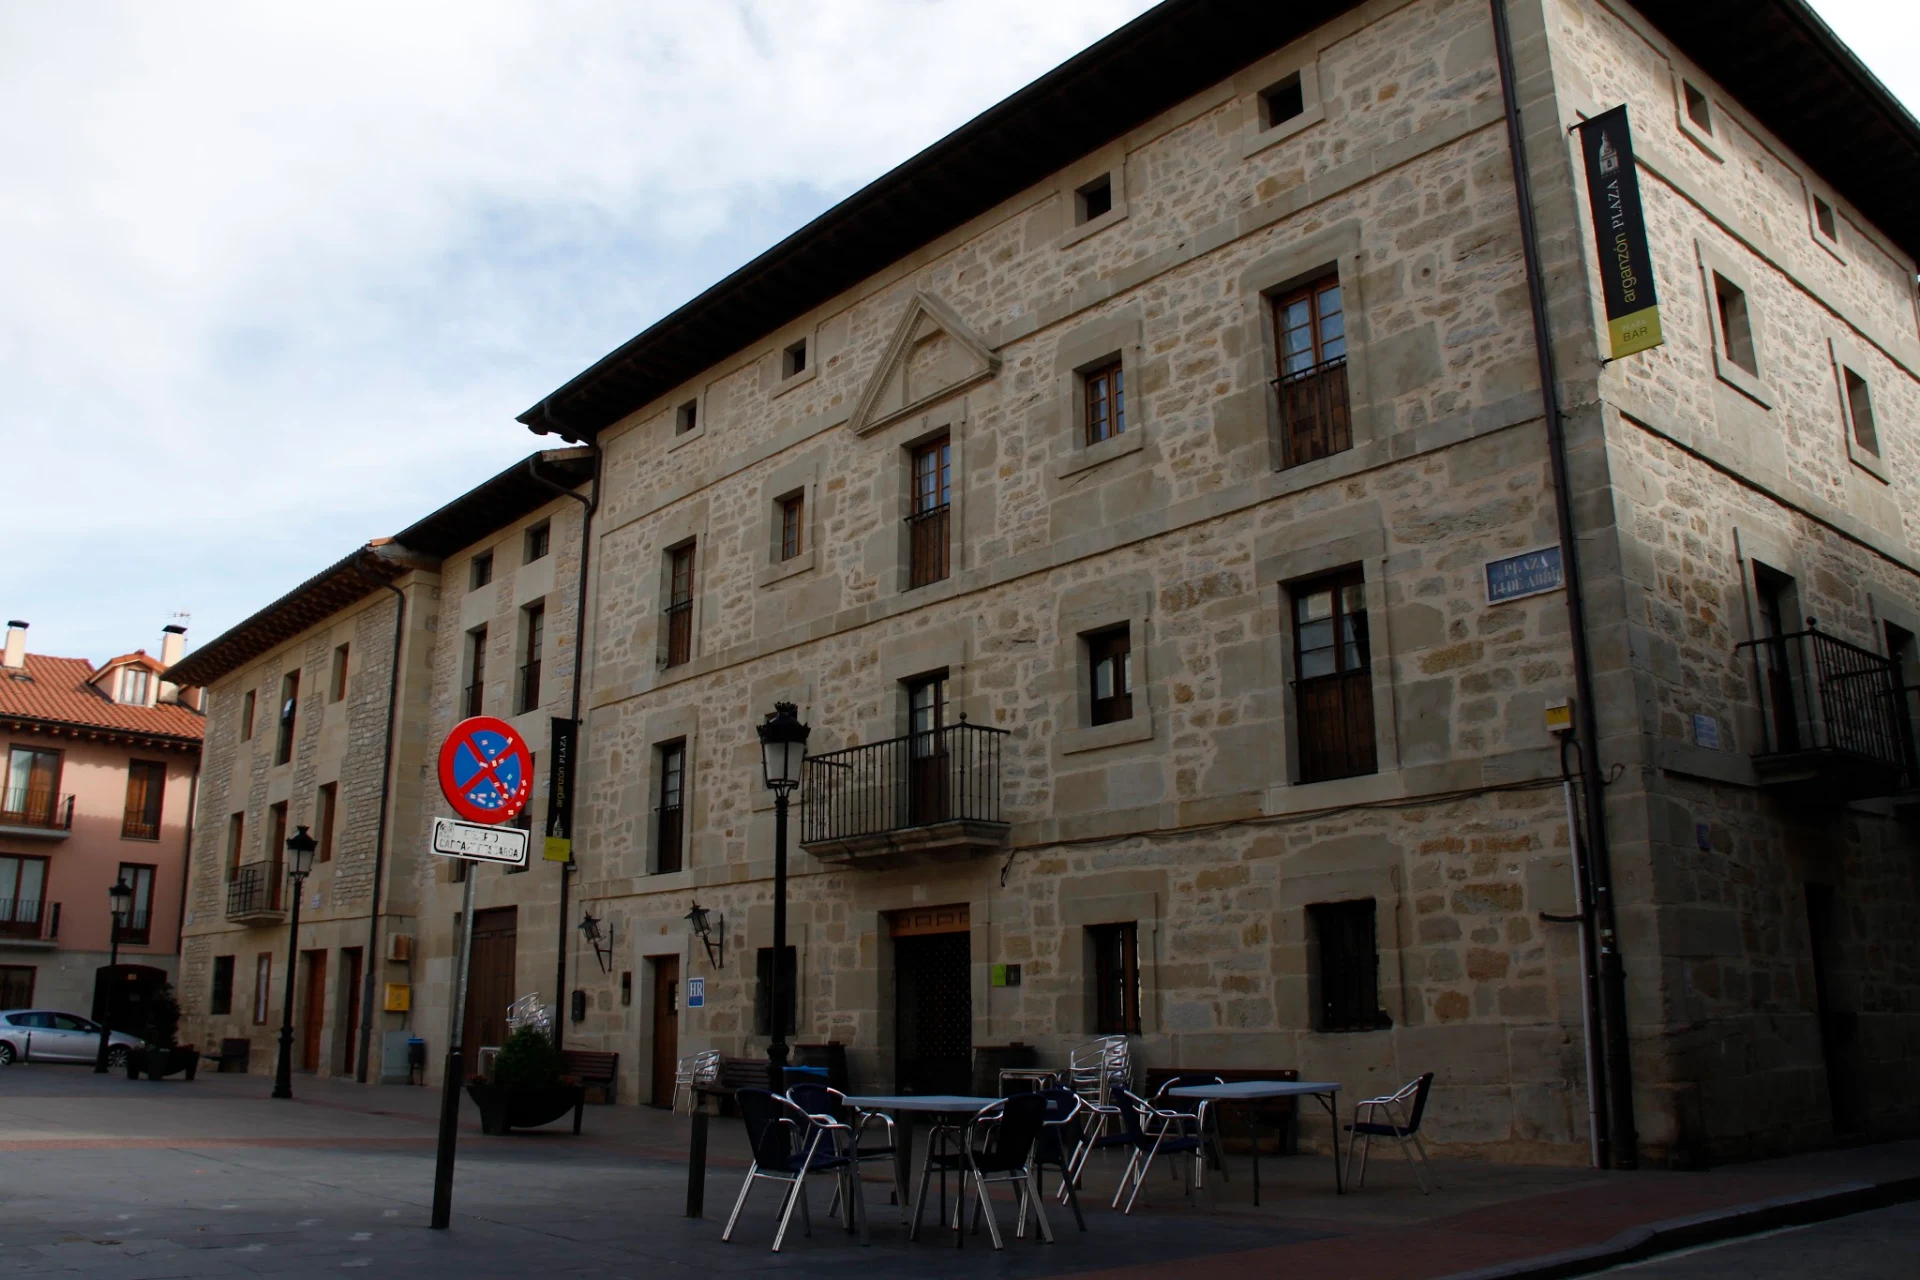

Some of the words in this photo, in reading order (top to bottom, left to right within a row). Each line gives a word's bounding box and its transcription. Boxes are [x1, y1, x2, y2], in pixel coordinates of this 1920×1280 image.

[1606, 179, 1625, 230] PLAZA
[1614, 232, 1637, 303] arganzón
[1622, 326, 1648, 342] BAR
[1504, 555, 1549, 576] PLAZA
[1492, 581, 1506, 596] 14
[1507, 577, 1524, 593] DE
[1526, 567, 1561, 588] ABRIL
[558, 735, 567, 764] PLAZA
[439, 838, 466, 851] CARA
[690, 981, 703, 997] HR
